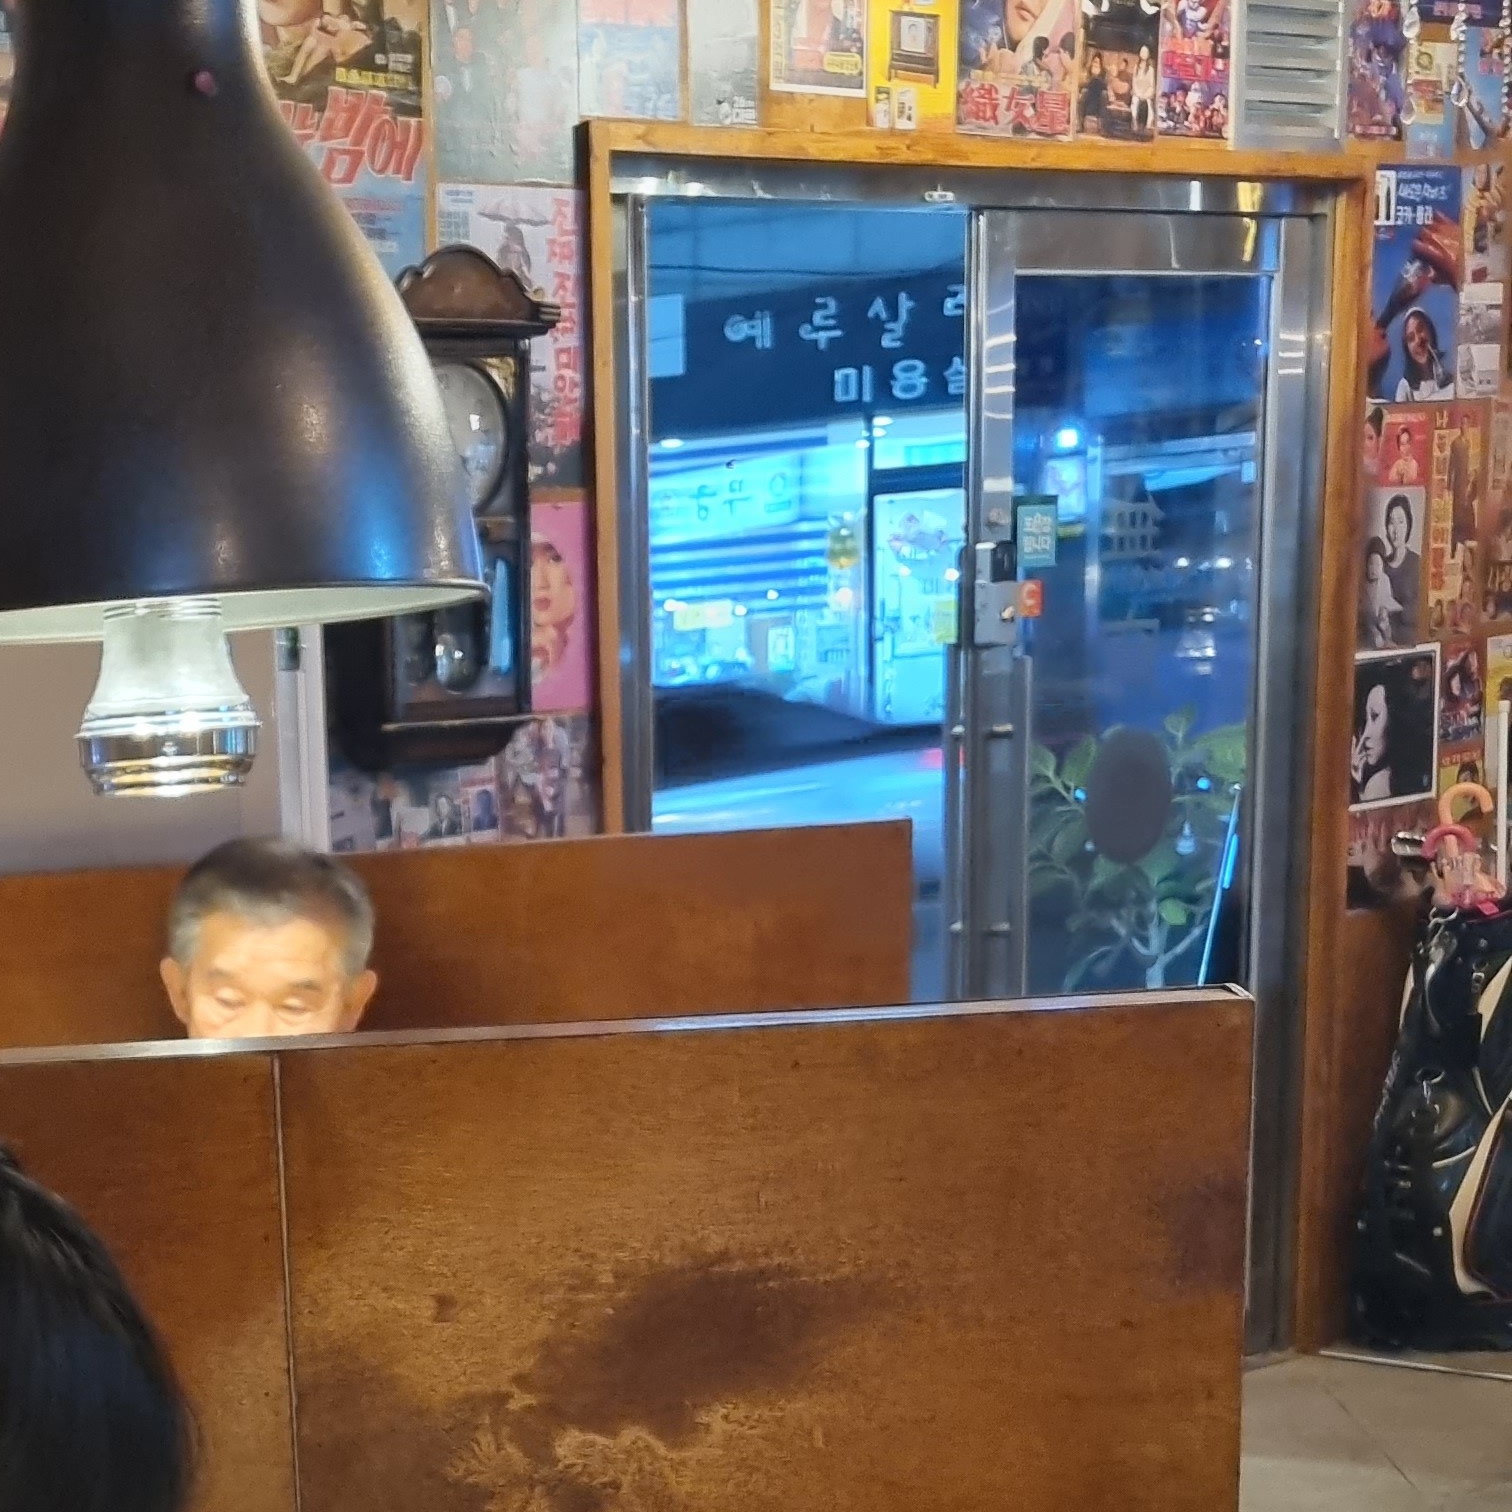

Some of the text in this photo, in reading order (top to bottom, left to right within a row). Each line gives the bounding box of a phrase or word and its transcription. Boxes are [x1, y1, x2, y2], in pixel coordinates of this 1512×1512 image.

[320, 86, 424, 187] 밤에
[959, 81, 1071, 136] 織女星
